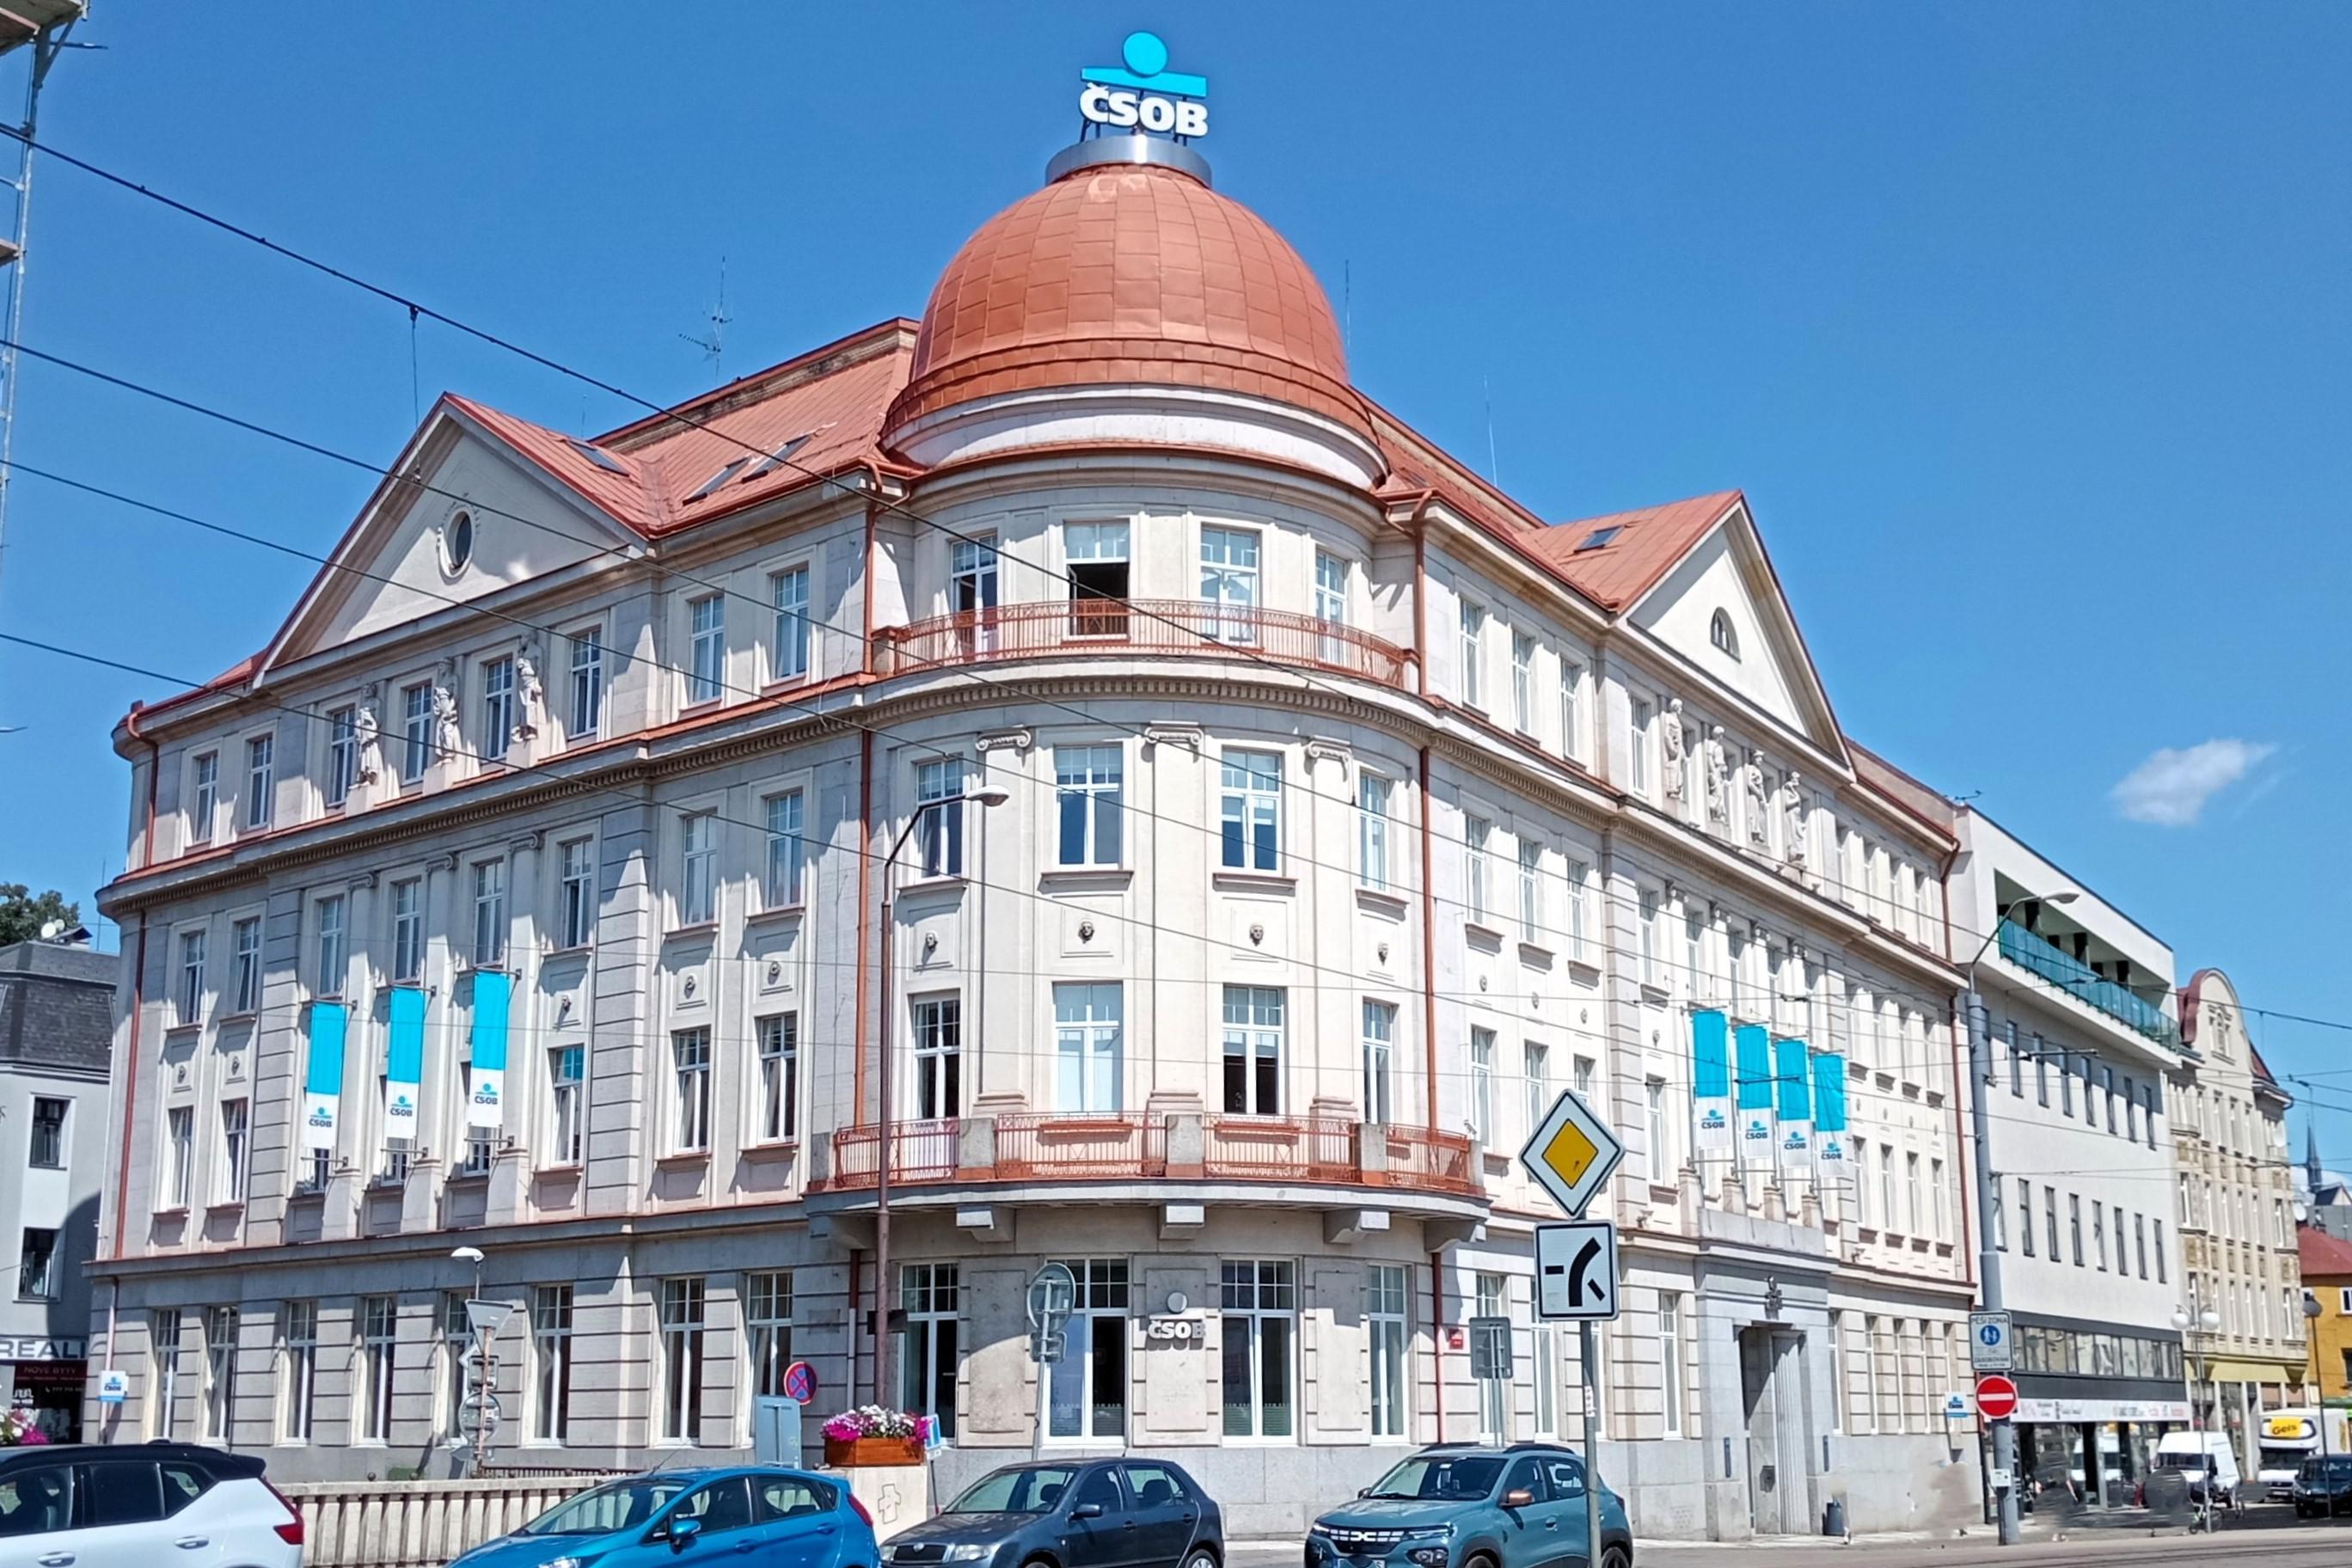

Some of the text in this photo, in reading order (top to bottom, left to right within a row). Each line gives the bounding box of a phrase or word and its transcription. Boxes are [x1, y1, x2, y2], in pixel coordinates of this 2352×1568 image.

[1080, 83, 1209, 137] ČSOB
[1148, 1320, 1206, 1339] ČSOB
[2272, 1424, 2297, 1435] Geis
